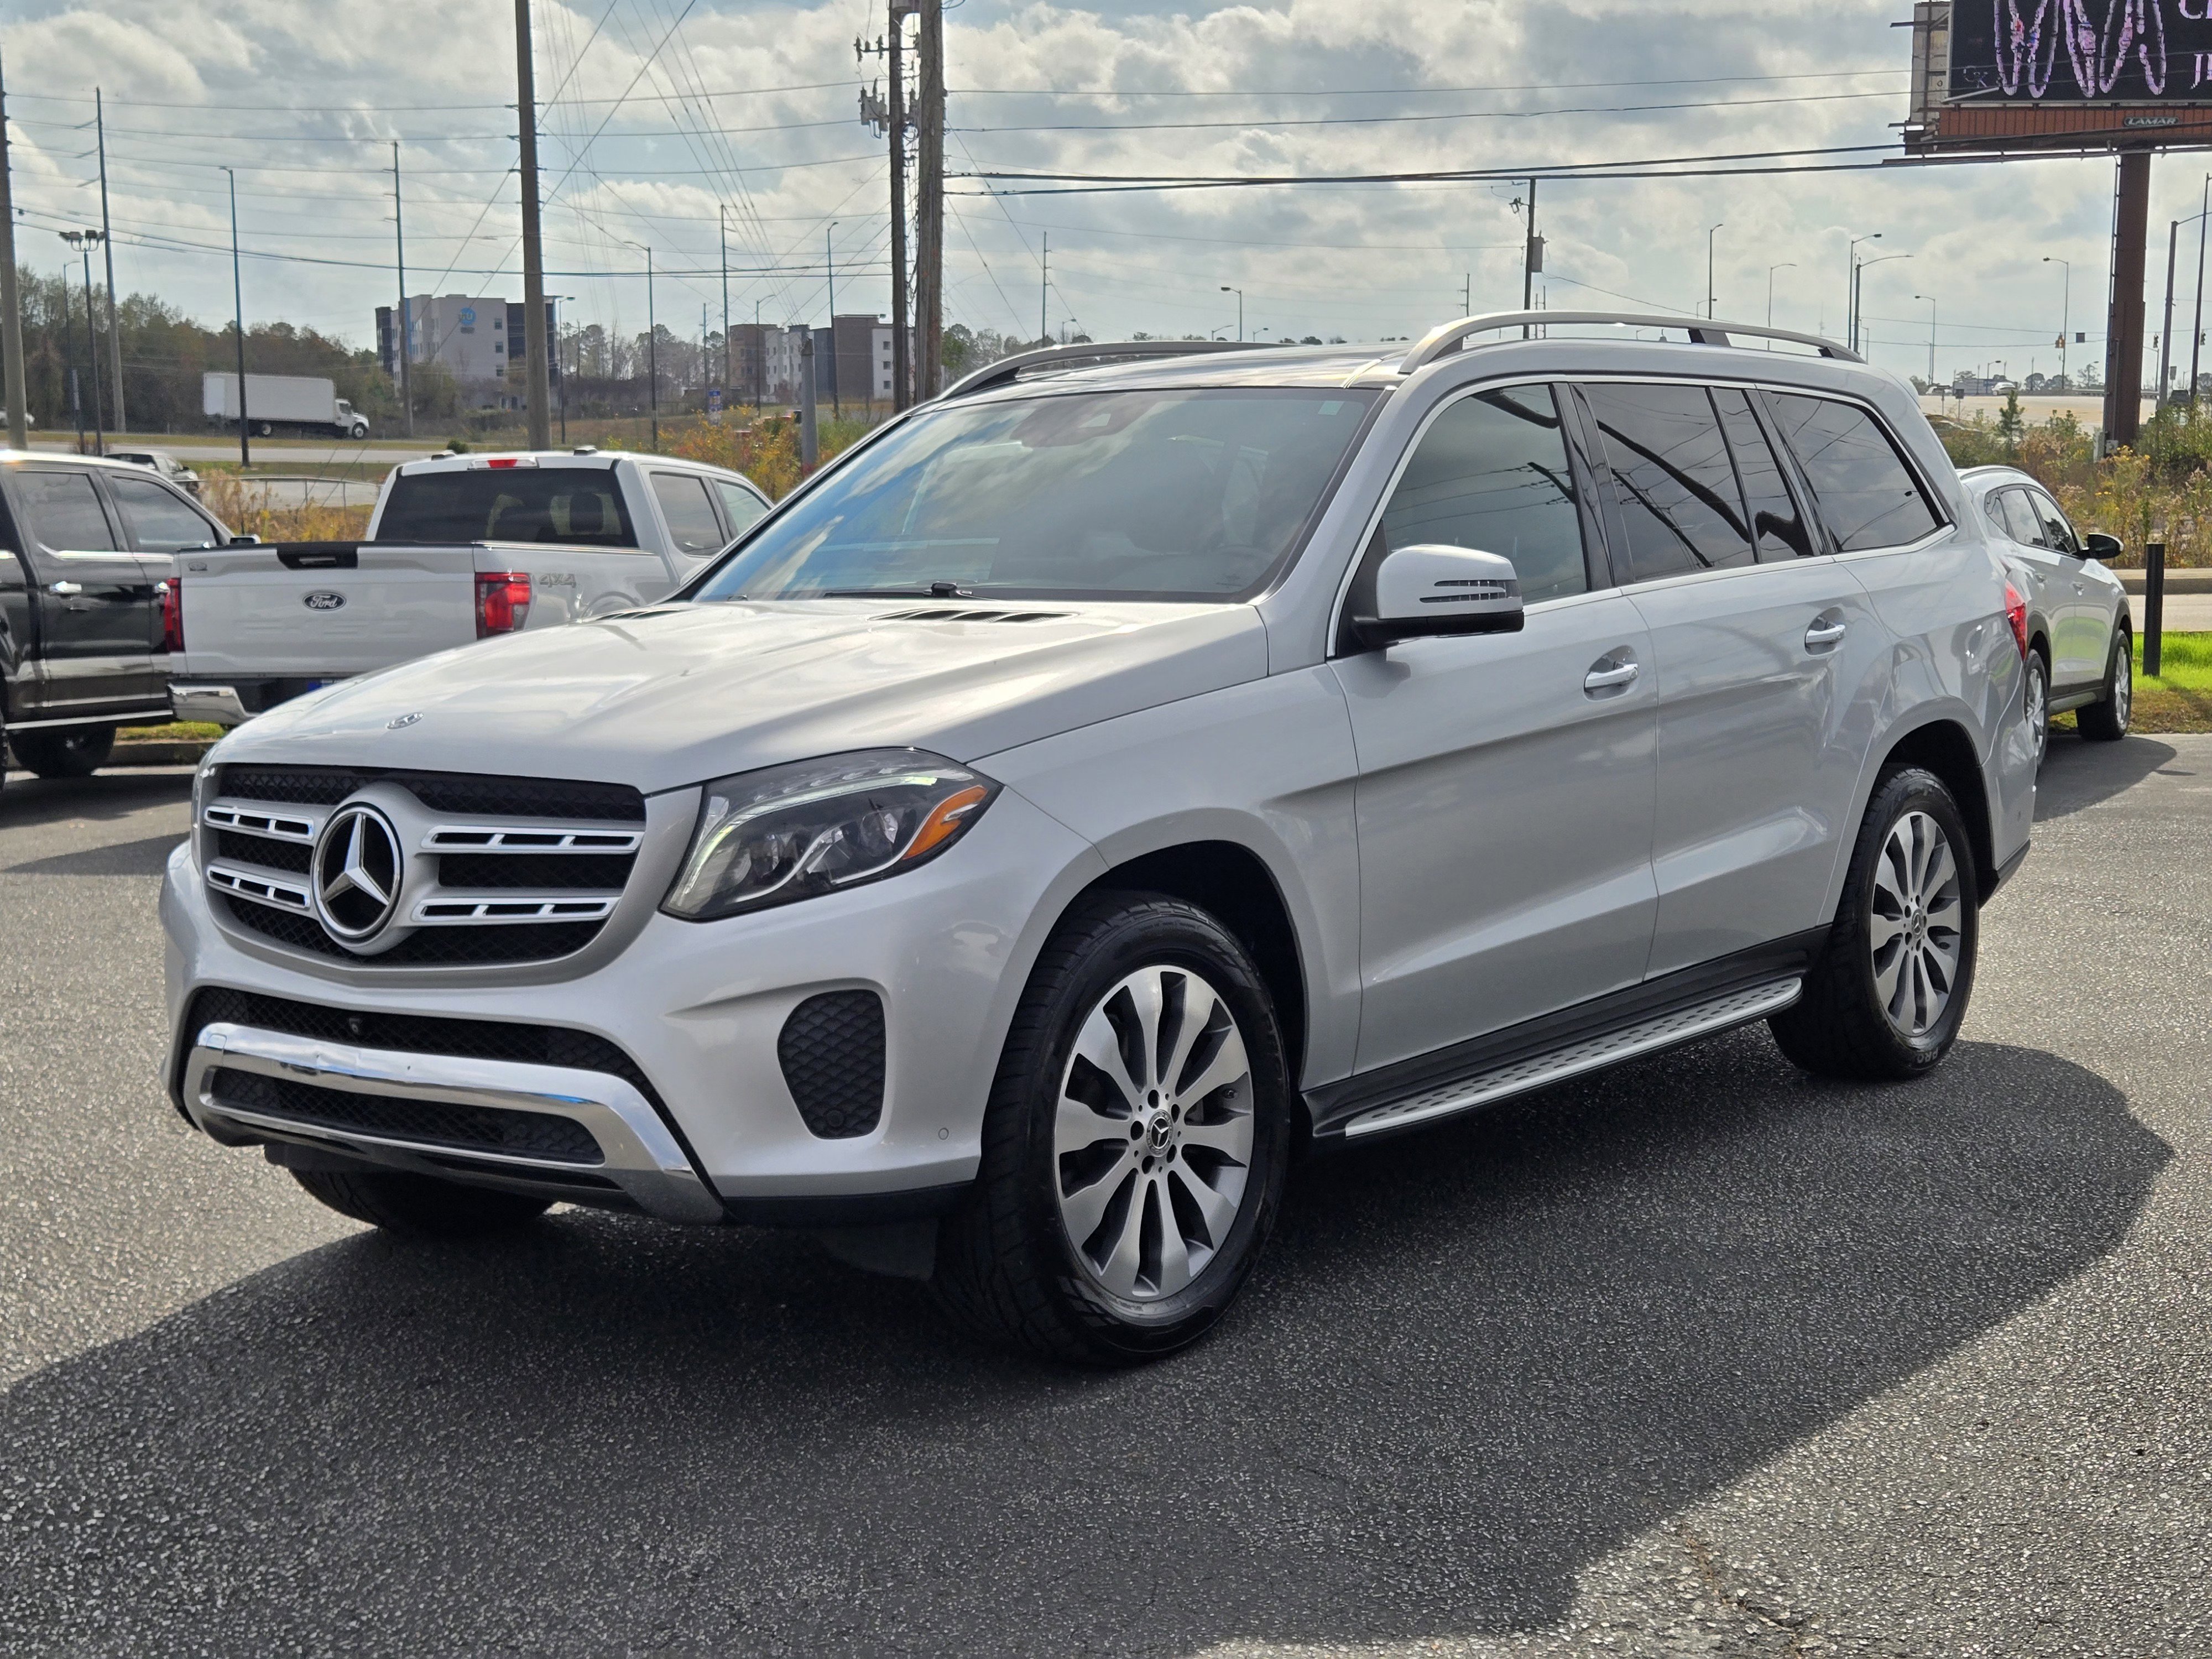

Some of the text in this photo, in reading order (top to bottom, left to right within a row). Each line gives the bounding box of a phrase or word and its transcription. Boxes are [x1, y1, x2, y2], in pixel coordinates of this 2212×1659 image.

[2178, 0, 2212, 19] C
[2190, 53, 2212, 90] J
[310, 595, 338, 608] Ford
